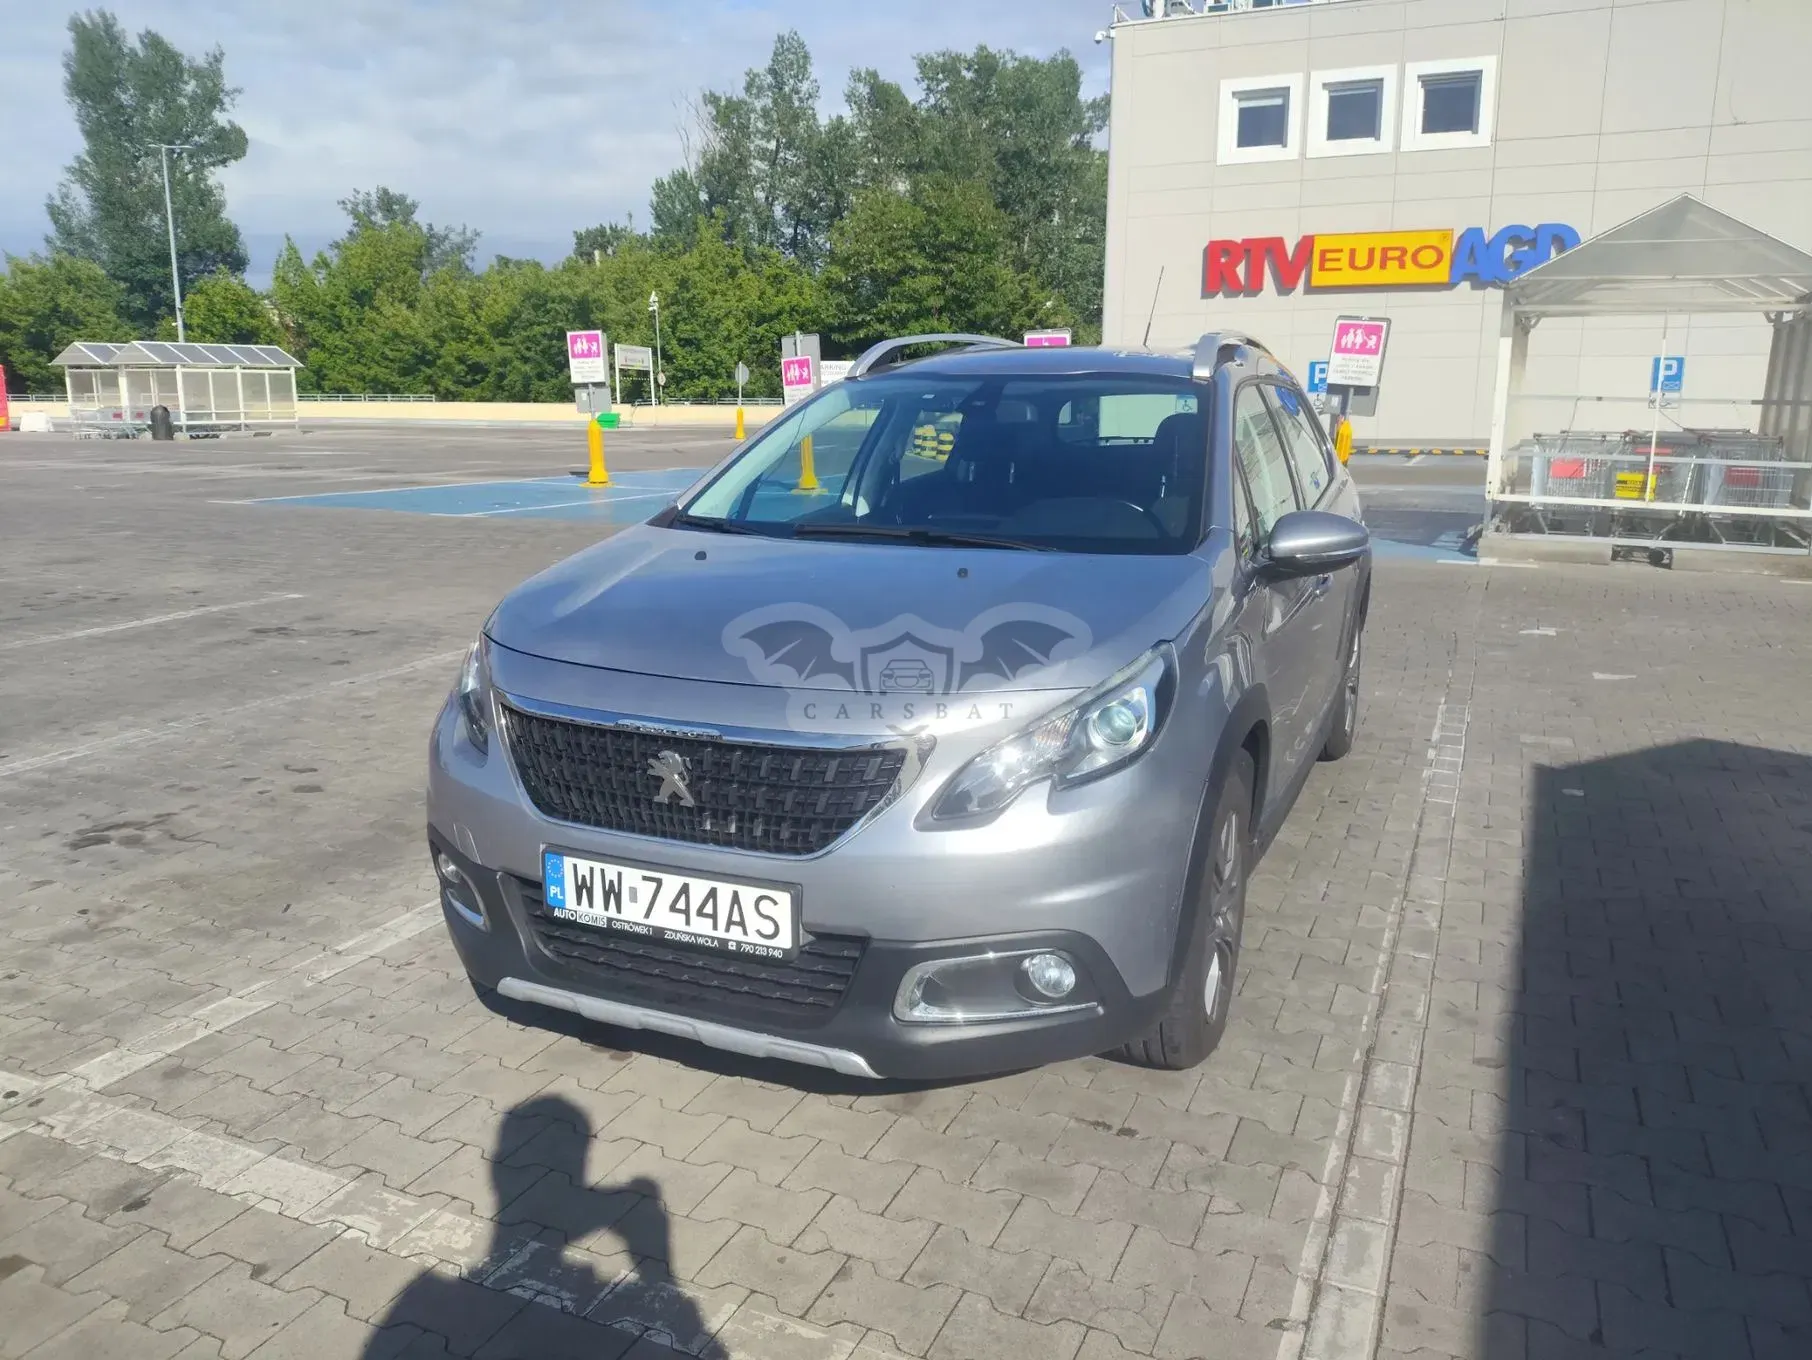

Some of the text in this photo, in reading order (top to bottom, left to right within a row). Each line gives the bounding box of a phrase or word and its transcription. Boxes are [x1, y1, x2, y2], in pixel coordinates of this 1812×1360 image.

[1204, 223, 1582, 292] RTV EURO AGD
[550, 885, 564, 900] PL
[572, 863, 780, 940] WW 744AS
[611, 920, 648, 935] OSTRÓWEK
[664, 930, 696, 944] ZDUŃSKA
[696, 937, 719, 948] WOLA
[740, 943, 754, 954] 790
[755, 946, 768, 956] 213
[768, 948, 783, 958] 940
